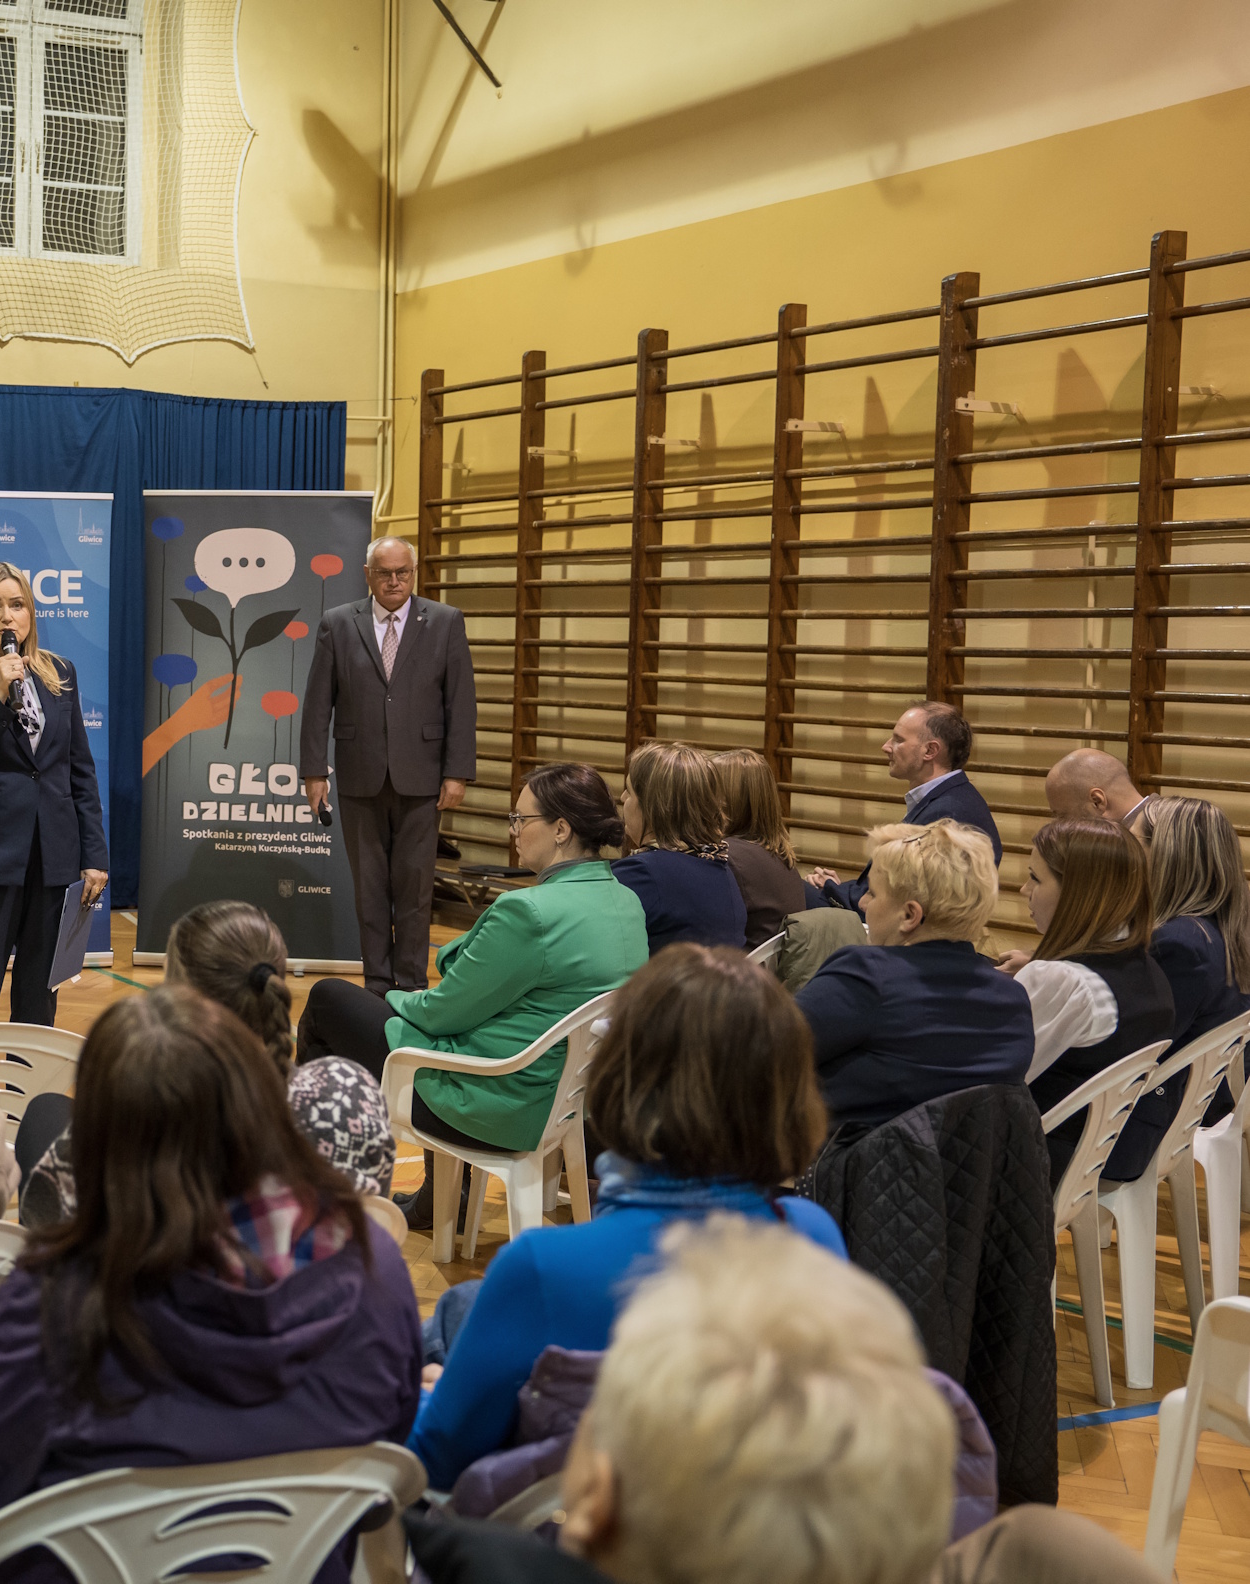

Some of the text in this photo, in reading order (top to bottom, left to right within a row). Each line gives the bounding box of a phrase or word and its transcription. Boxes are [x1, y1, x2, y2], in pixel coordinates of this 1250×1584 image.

[35, 609, 55, 618] ture
[57, 608, 65, 618] is
[67, 608, 89, 618] here
[83, 719, 102, 727] liwice
[182, 828, 332, 843] Spotkania z prezydent Gliwic
[214, 842, 331, 856] Katarzyną Kuczyńską-Budką
[298, 886, 331, 894] GLIWICE
